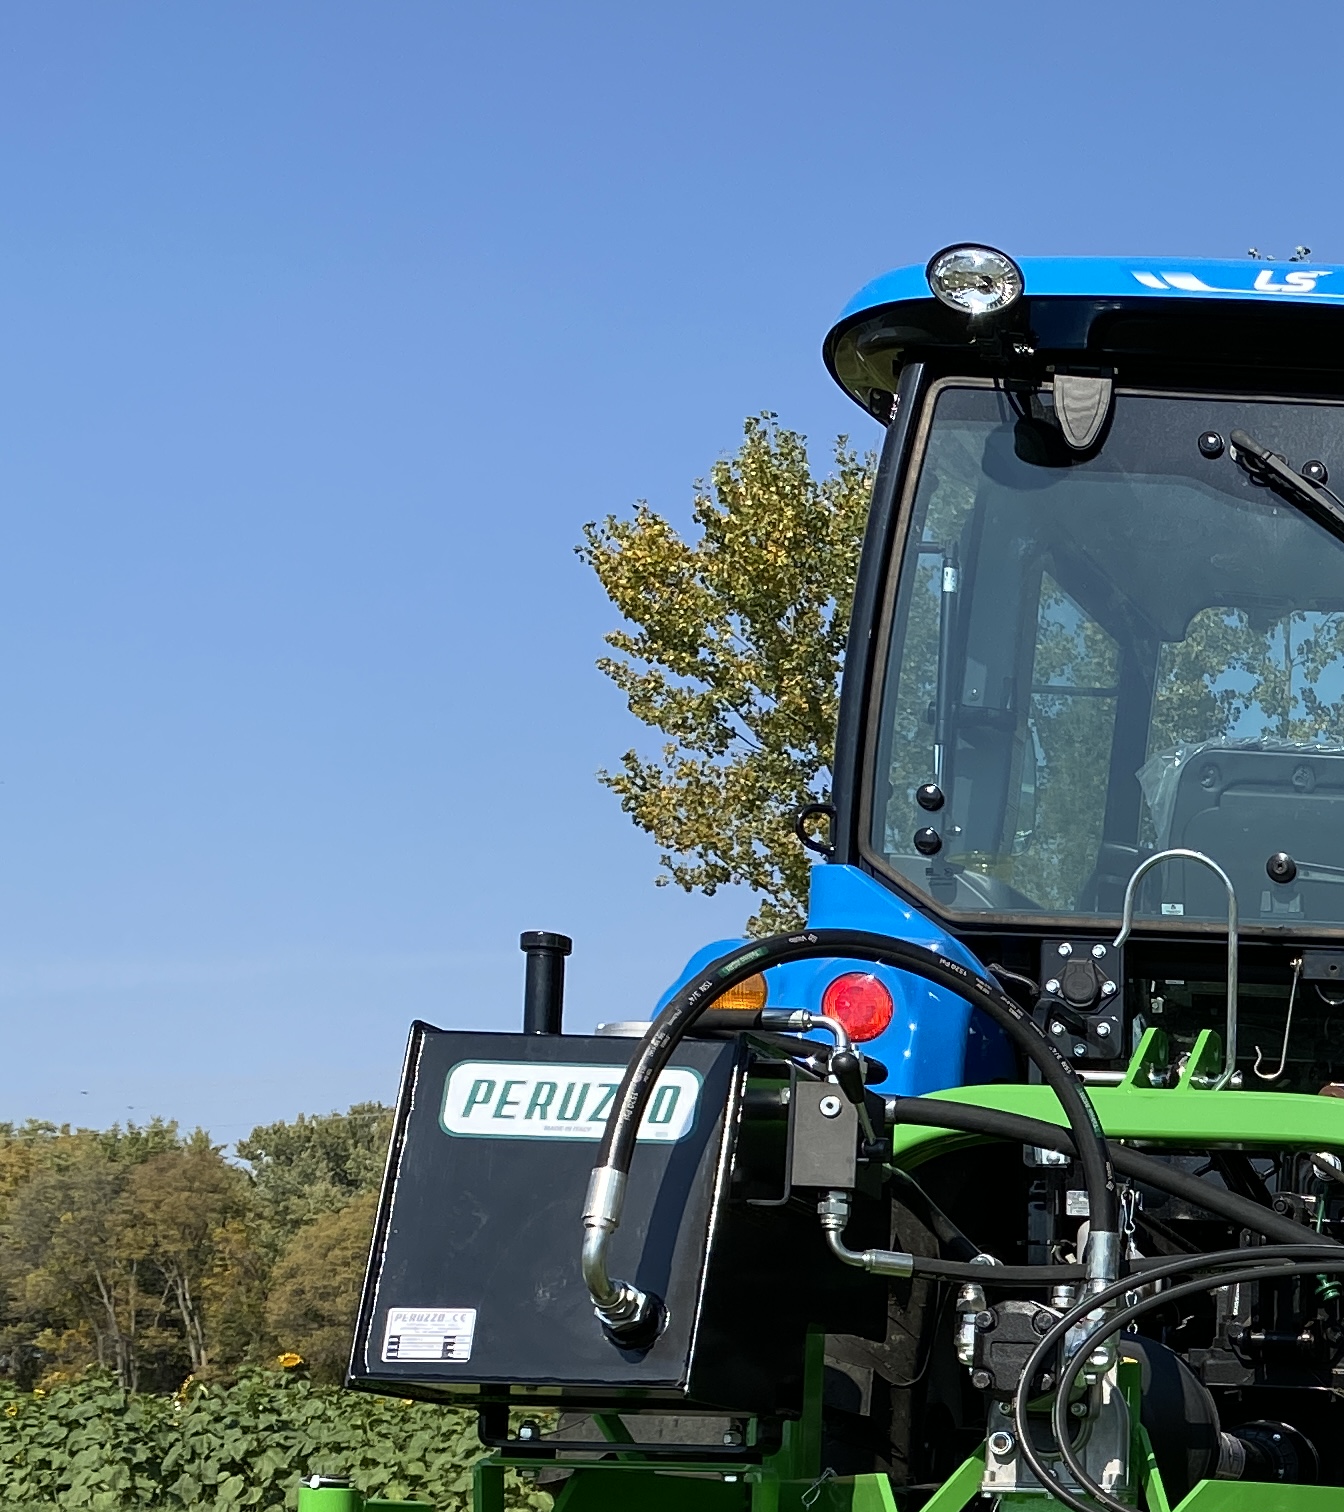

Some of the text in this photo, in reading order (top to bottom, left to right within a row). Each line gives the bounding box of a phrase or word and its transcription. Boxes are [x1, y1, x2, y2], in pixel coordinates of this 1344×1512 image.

[1254, 270, 1333, 292] LS
[461, 1079, 682, 1124] PERUZO
[394, 1313, 446, 1323] PERUZZO
